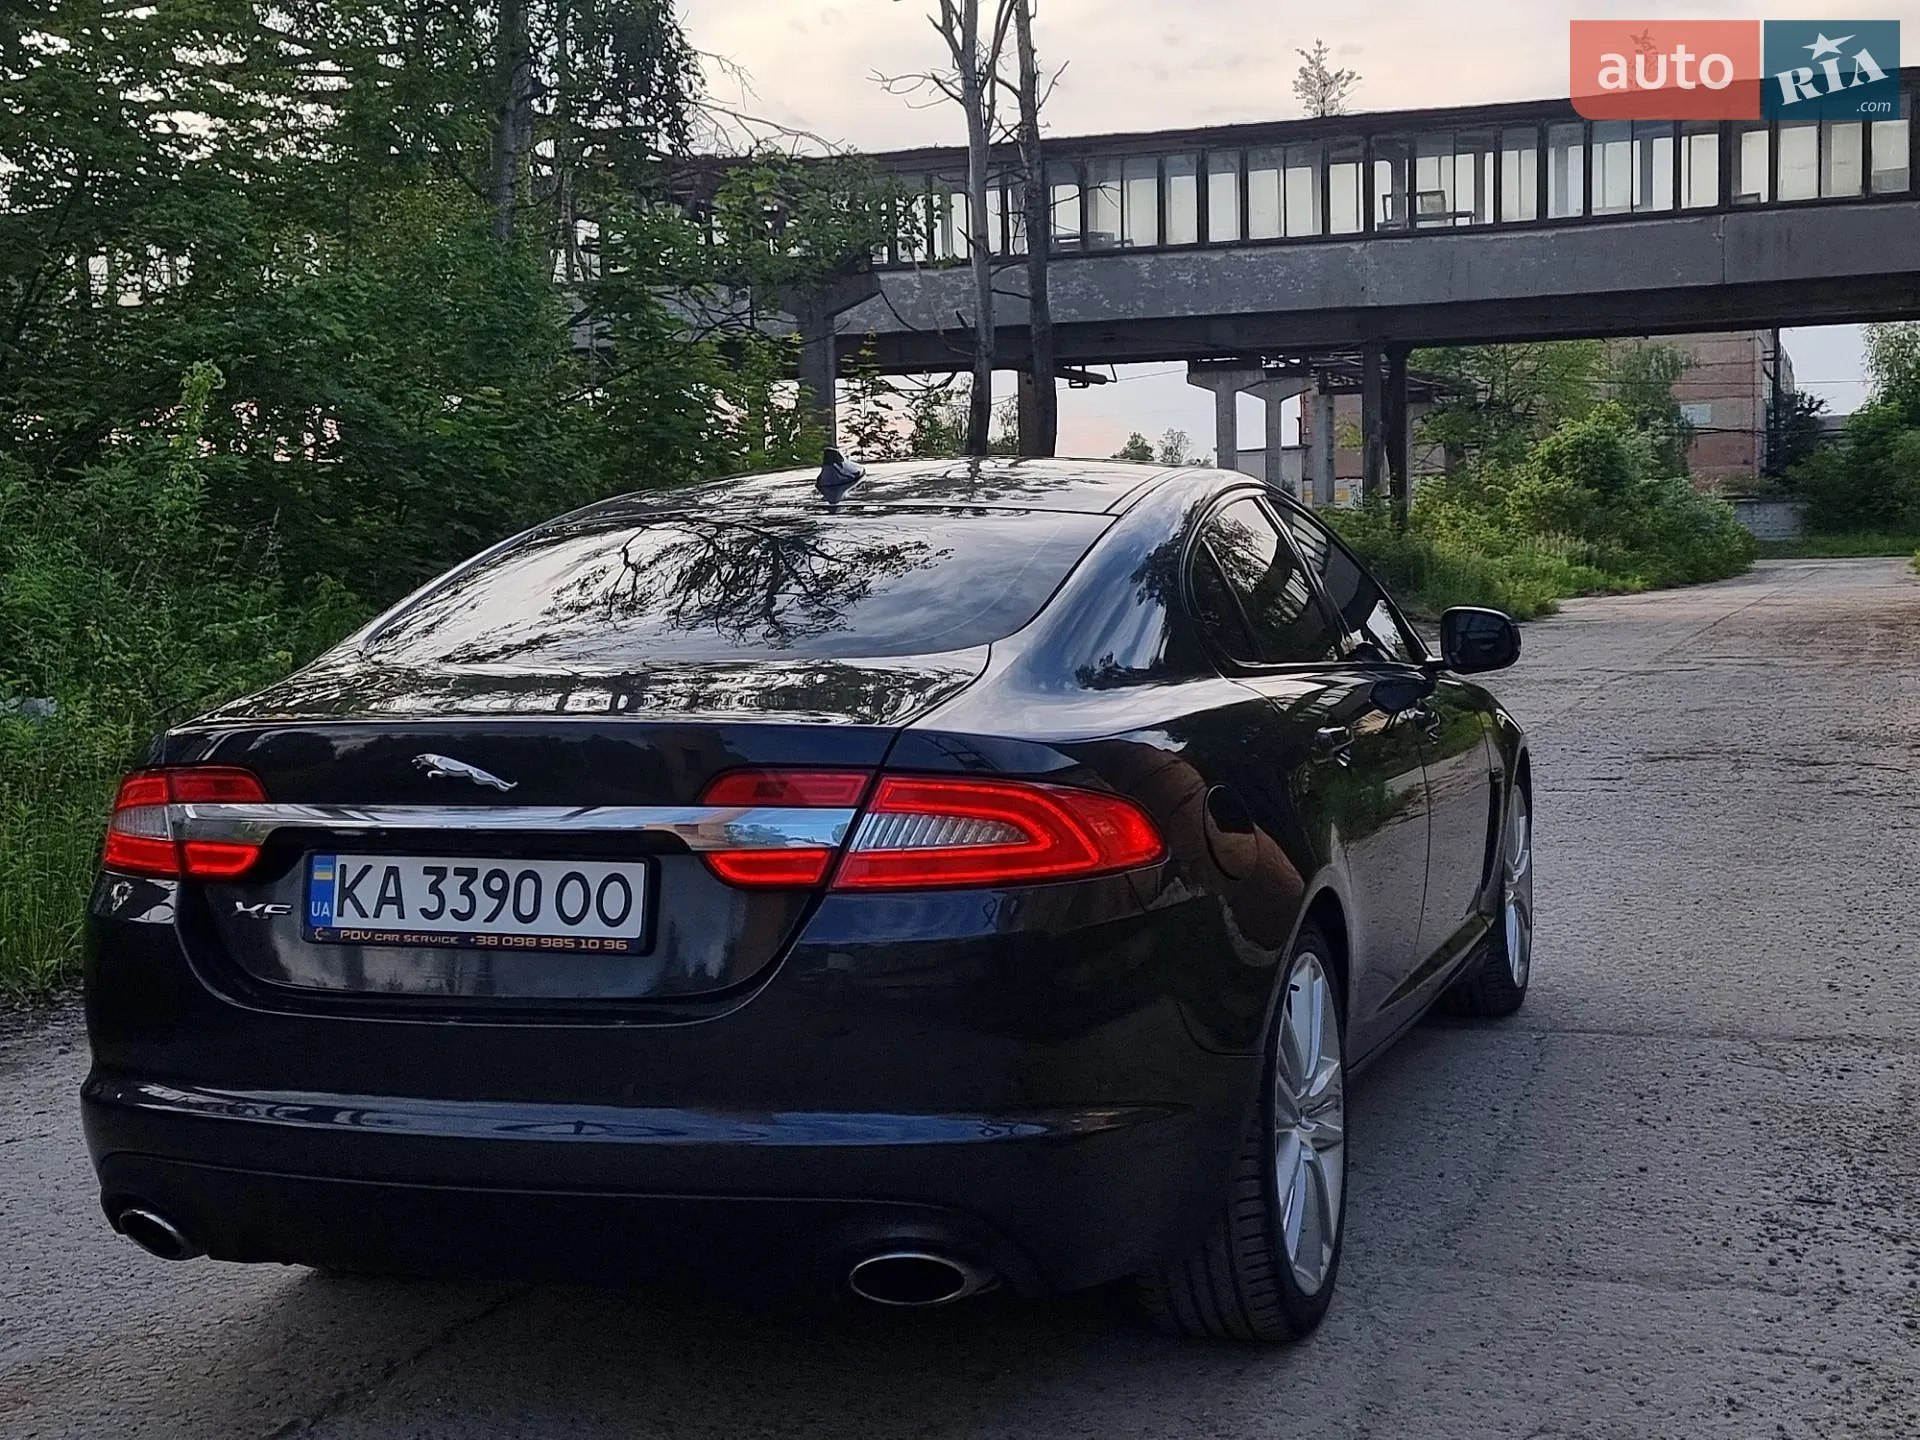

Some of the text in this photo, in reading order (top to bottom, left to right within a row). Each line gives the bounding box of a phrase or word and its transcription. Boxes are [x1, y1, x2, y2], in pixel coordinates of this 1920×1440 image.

[336, 863, 633, 928] KA 3390 OO
[311, 901, 330, 917] UA
[374, 933, 400, 943] CAR
[402, 933, 459, 945] SERVICE
[469, 935, 498, 946] +38
[502, 936, 537, 947] 098
[541, 938, 575, 949] 985
[579, 939, 600, 950] 10
[604, 940, 628, 951] 96
